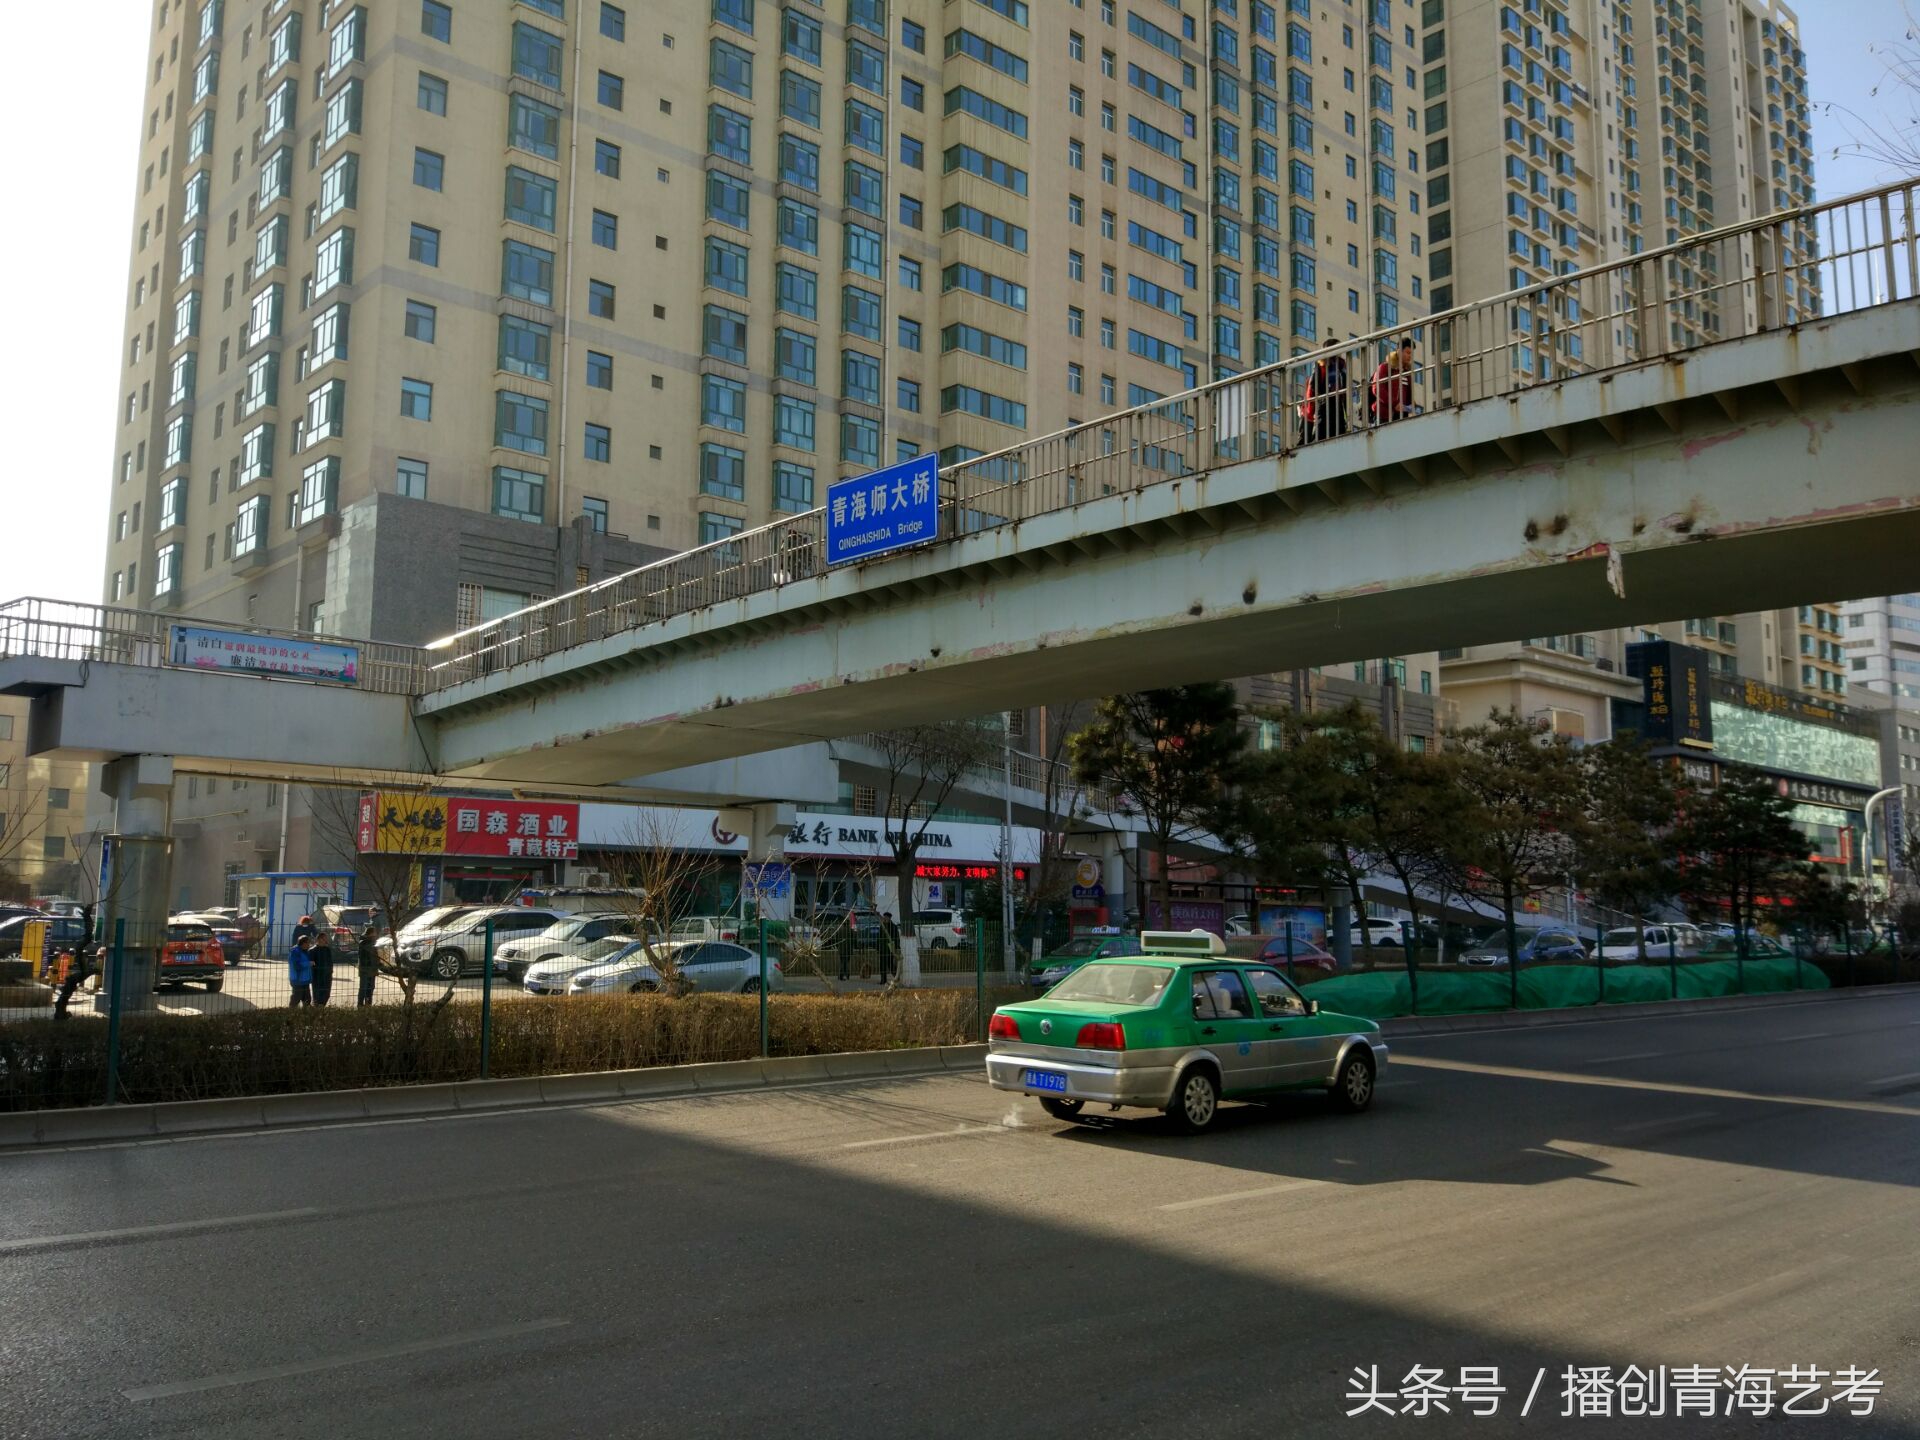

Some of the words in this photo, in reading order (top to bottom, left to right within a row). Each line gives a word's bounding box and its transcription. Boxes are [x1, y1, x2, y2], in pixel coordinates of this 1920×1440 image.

[832, 470, 930, 528] 青海师大桥
[838, 527, 892, 551] QINGHAISHIDA
[897, 520, 923, 535] Bridge
[361, 804, 371, 847] 超市
[457, 808, 568, 837] 国森酒业
[838, 827, 878, 843] BANK
[910, 832, 952, 847] CHINA
[507, 838, 578, 857] 青藏特产
